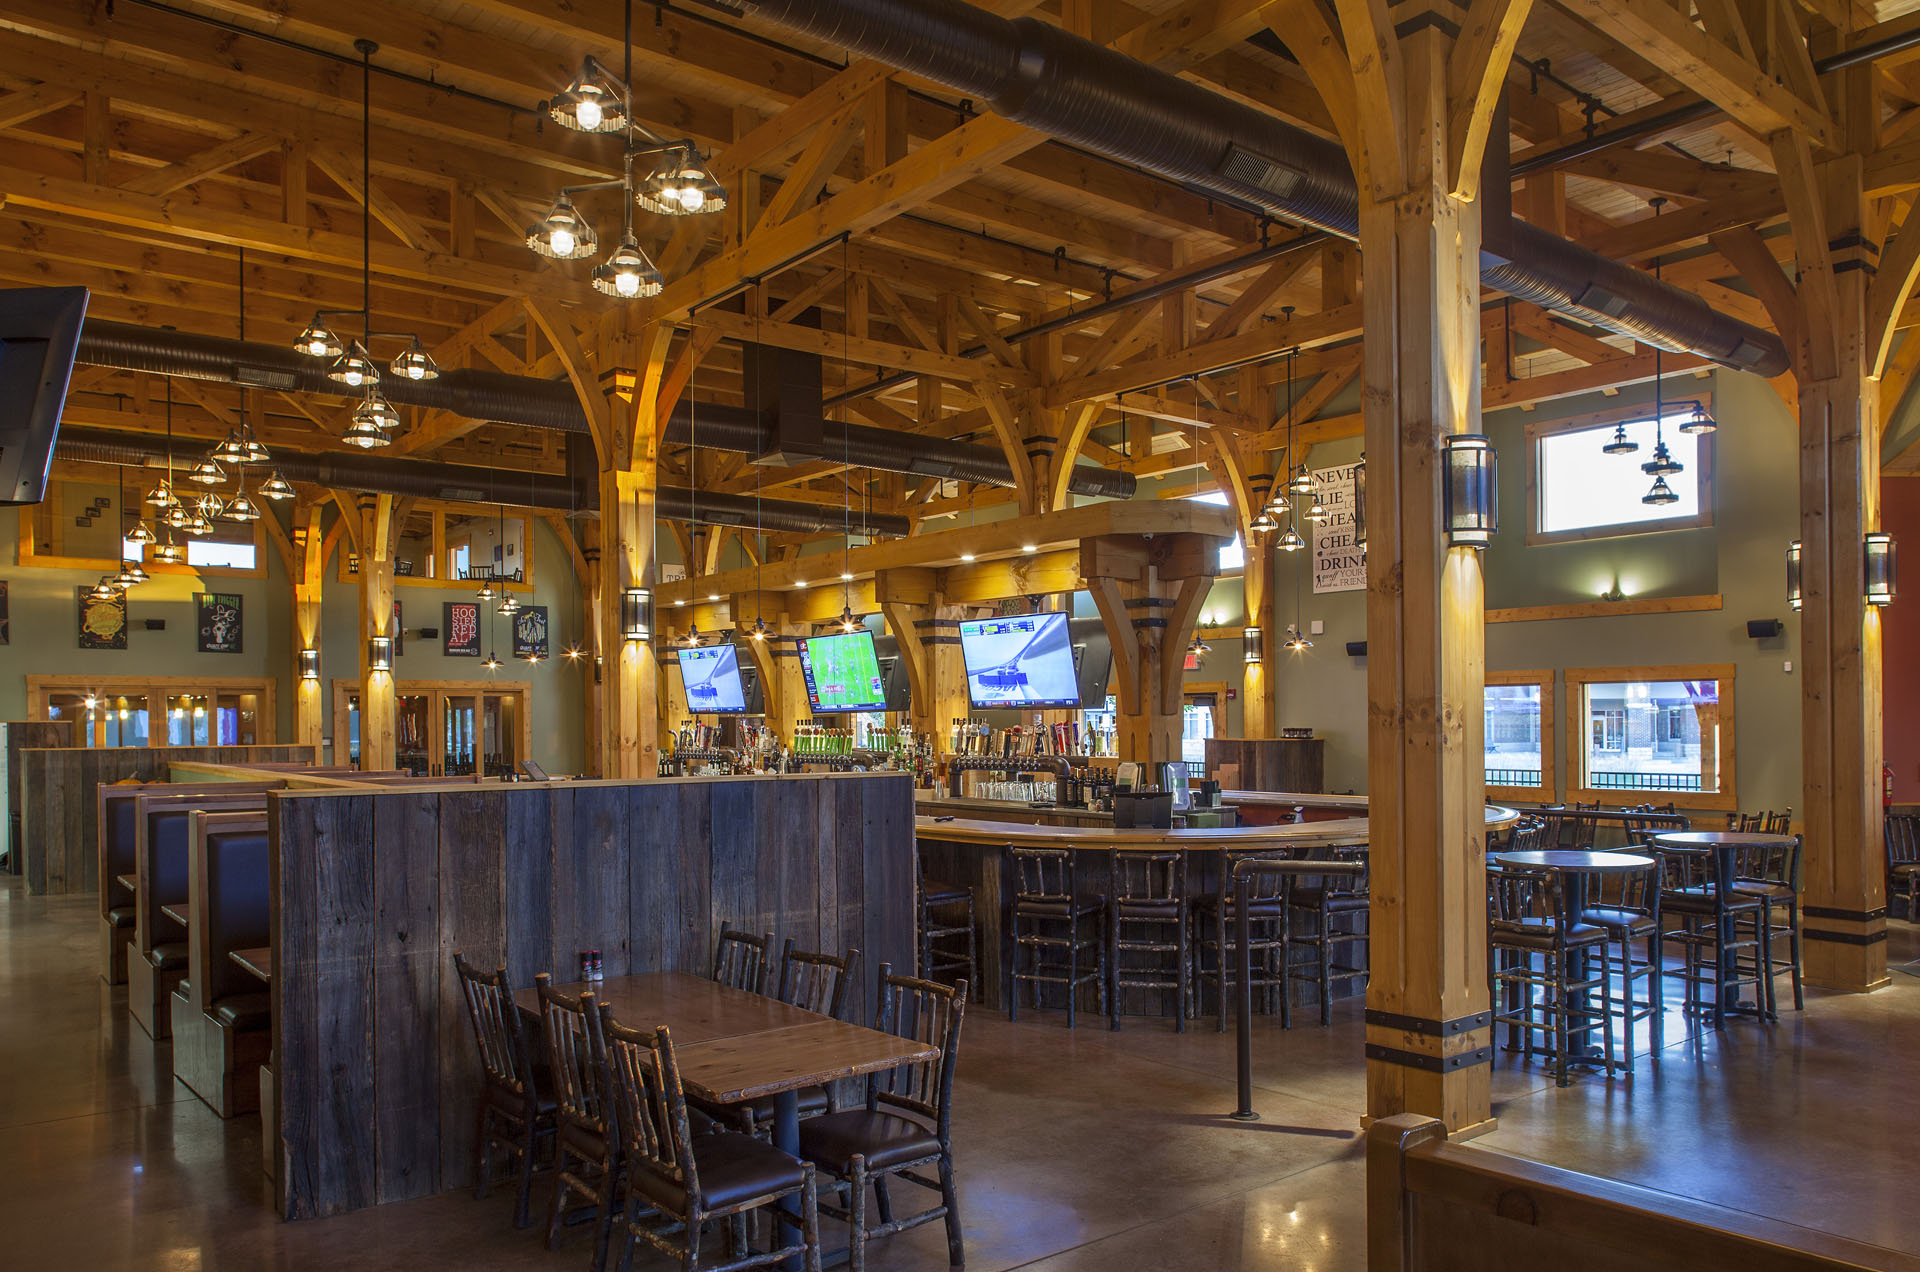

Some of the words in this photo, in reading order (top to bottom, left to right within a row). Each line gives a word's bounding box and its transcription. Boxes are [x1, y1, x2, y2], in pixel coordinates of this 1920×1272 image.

[1315, 467, 1356, 483] NEVE
[1320, 491, 1343, 505] LIE
[1320, 511, 1356, 527] STEA
[1320, 535, 1356, 549] CHE
[1340, 568, 1364, 577] YOUR
[452, 608, 477, 618] HOO
[452, 617, 477, 626] SIER
[452, 625, 477, 634] RED
